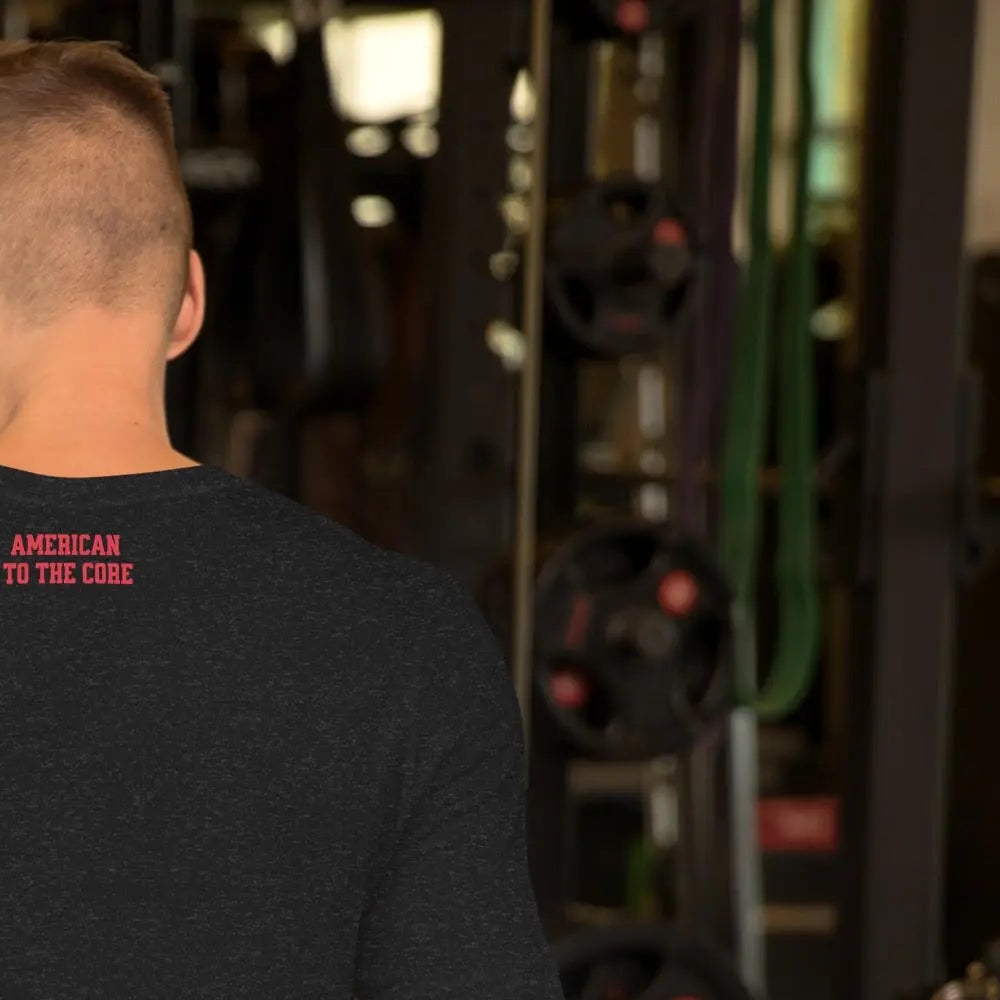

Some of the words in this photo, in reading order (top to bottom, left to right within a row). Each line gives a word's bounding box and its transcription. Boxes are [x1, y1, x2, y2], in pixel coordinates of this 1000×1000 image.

[10, 533, 121, 557] AMERICAN
[2, 562, 30, 585] TO
[35, 562, 77, 585] THE
[82, 562, 134, 585] CORE
